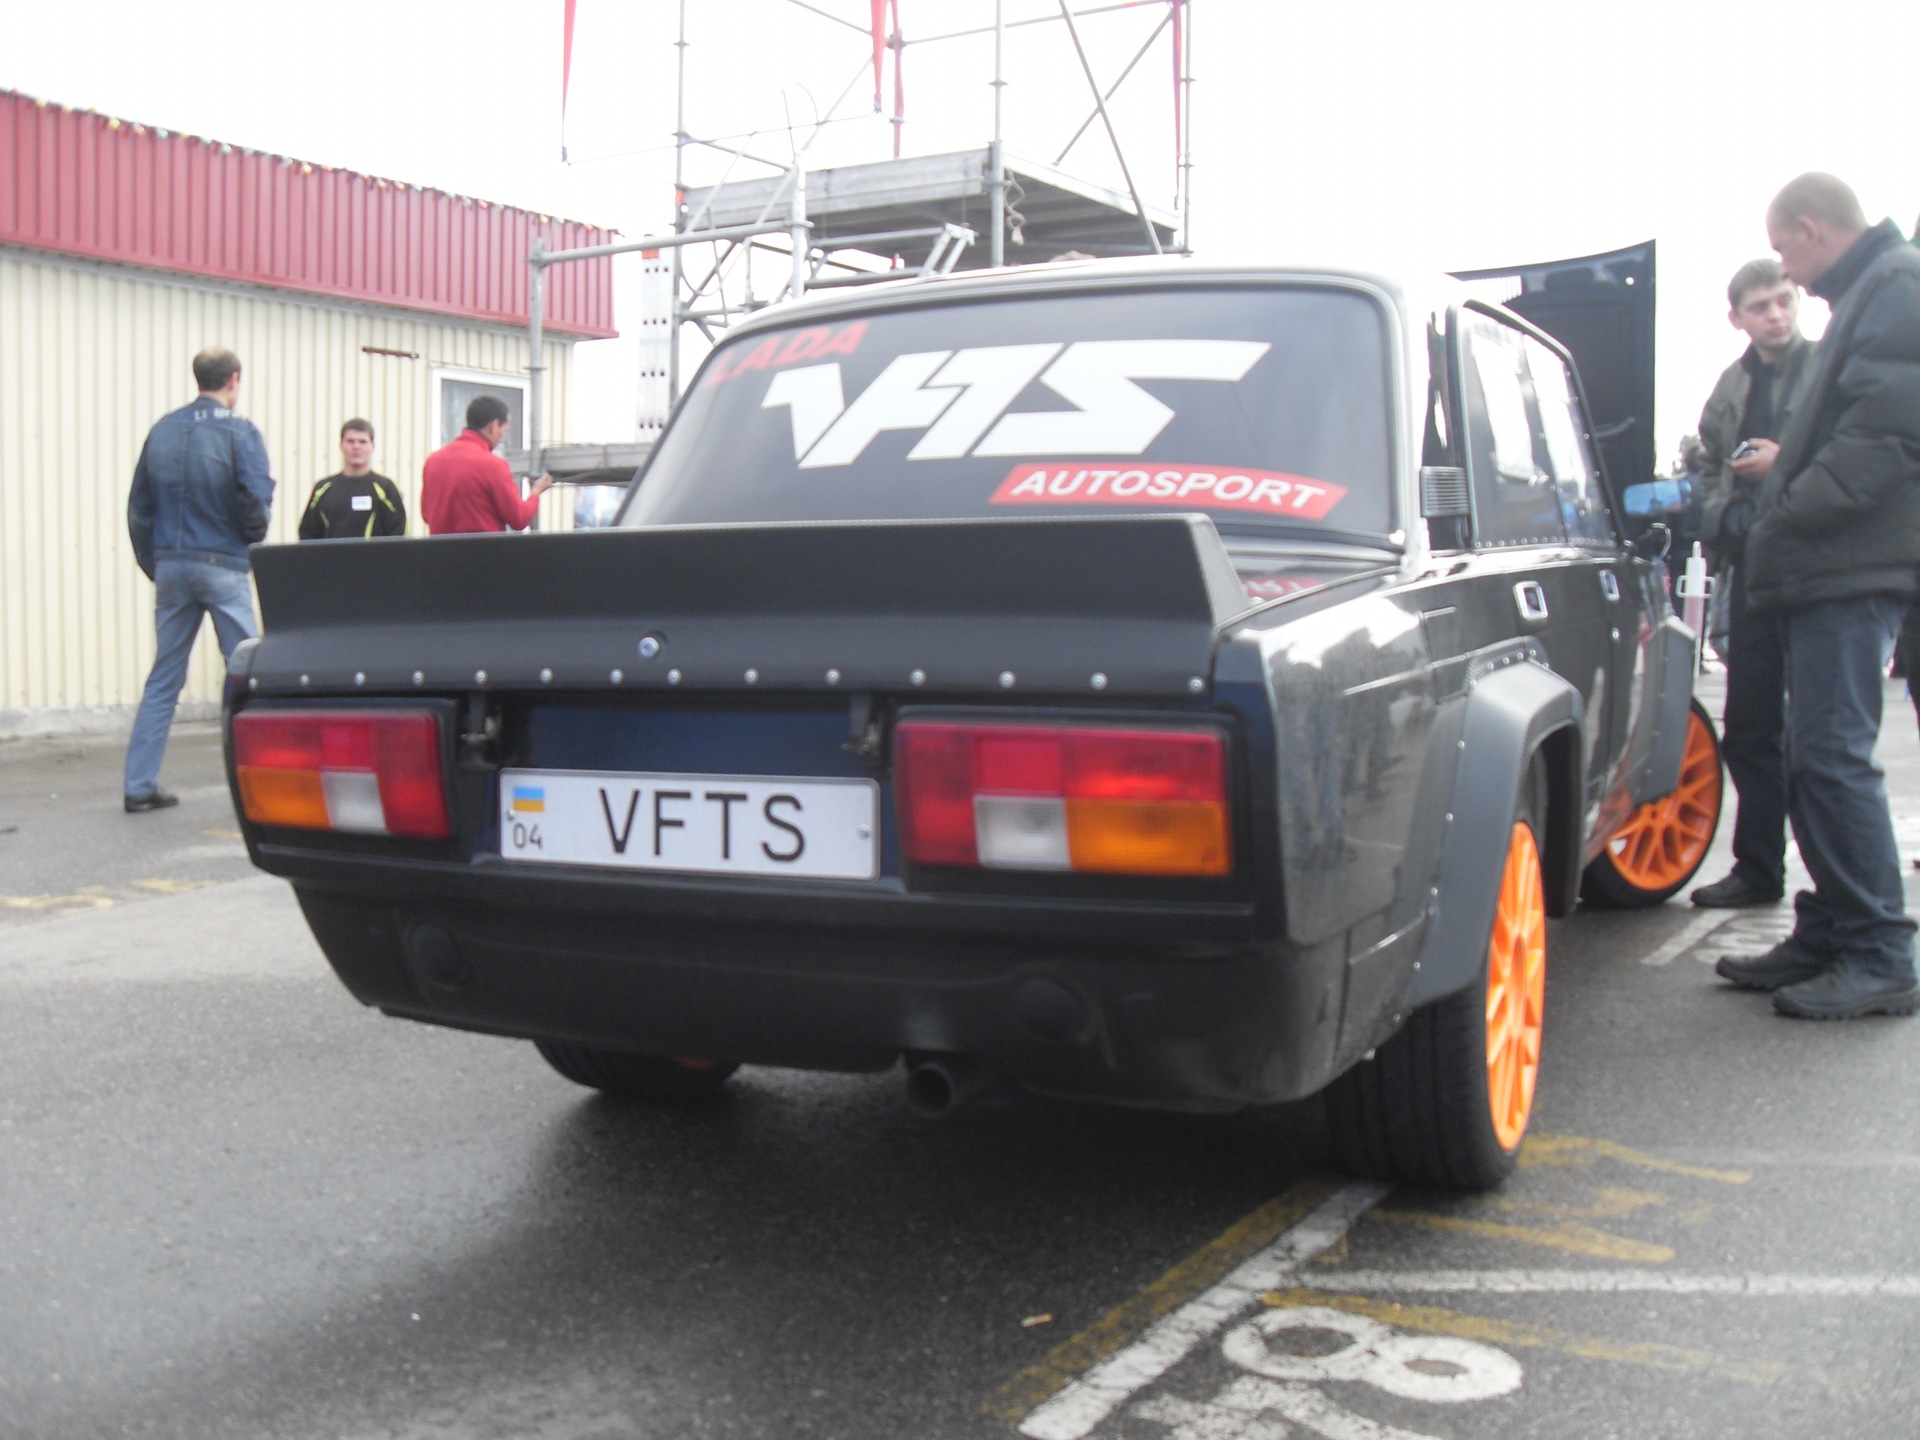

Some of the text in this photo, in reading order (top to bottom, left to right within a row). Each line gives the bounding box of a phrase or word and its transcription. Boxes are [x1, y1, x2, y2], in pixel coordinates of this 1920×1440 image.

[703, 320, 868, 389] LADA
[1010, 470, 1327, 509] AUTOSPORT
[513, 822, 543, 850] 04
[599, 788, 806, 863] VFTS
